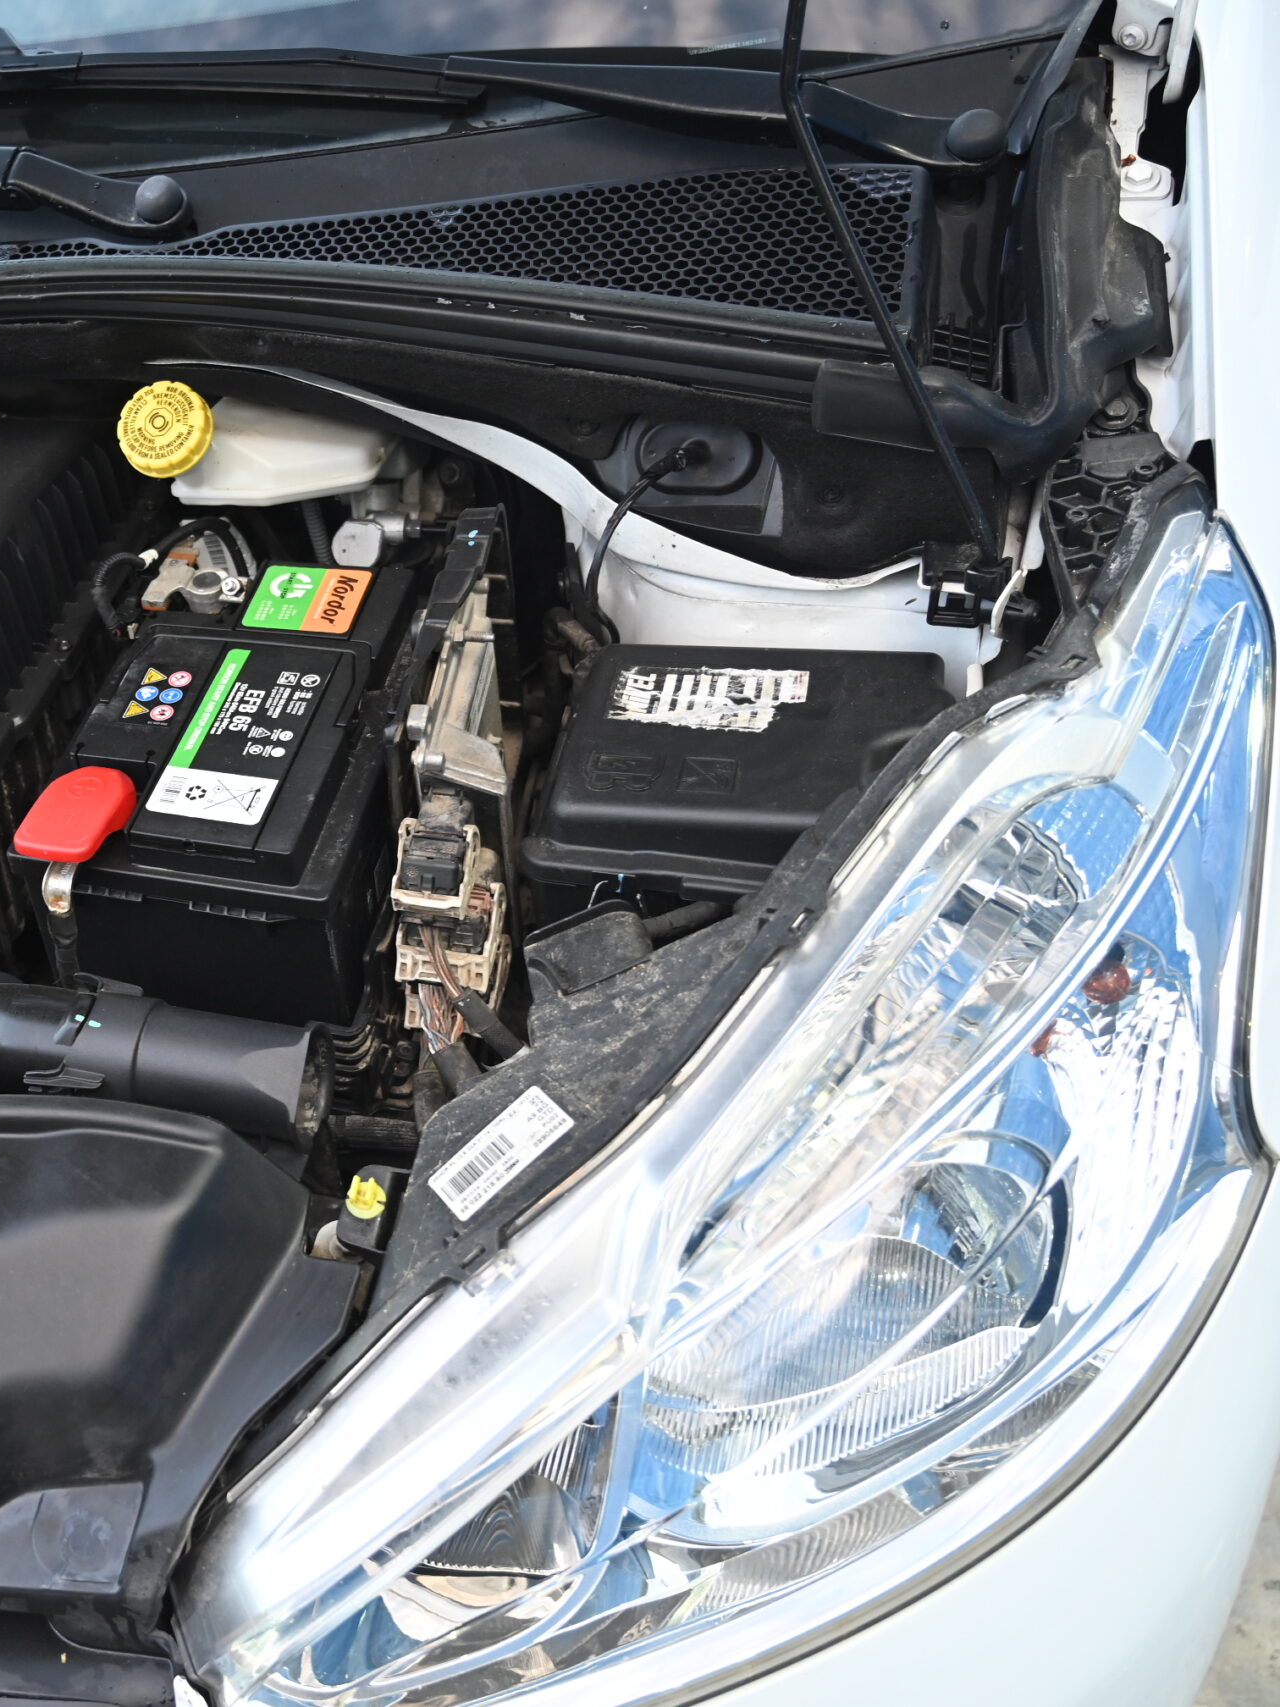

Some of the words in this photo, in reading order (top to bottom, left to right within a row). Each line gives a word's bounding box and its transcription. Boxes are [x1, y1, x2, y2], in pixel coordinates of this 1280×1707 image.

[131, 434, 140, 444] CAP
[138, 442, 157, 452] BEFORE
[159, 432, 184, 451] REMOVING
[136, 448, 149, 458] FROM
[154, 449, 174, 460] SEALED
[174, 424, 194, 452] CONTAINER
[137, 427, 156, 445] WARNING
[288, 572, 296, 584] START
[280, 587, 288, 599] STOP
[320, 576, 358, 624] Nordor
[212, 685, 225, 701] START
[238, 689, 266, 713] EFB
[205, 702, 215, 712] AND
[199, 712, 210, 726] STOP
[228, 715, 251, 731] 65
